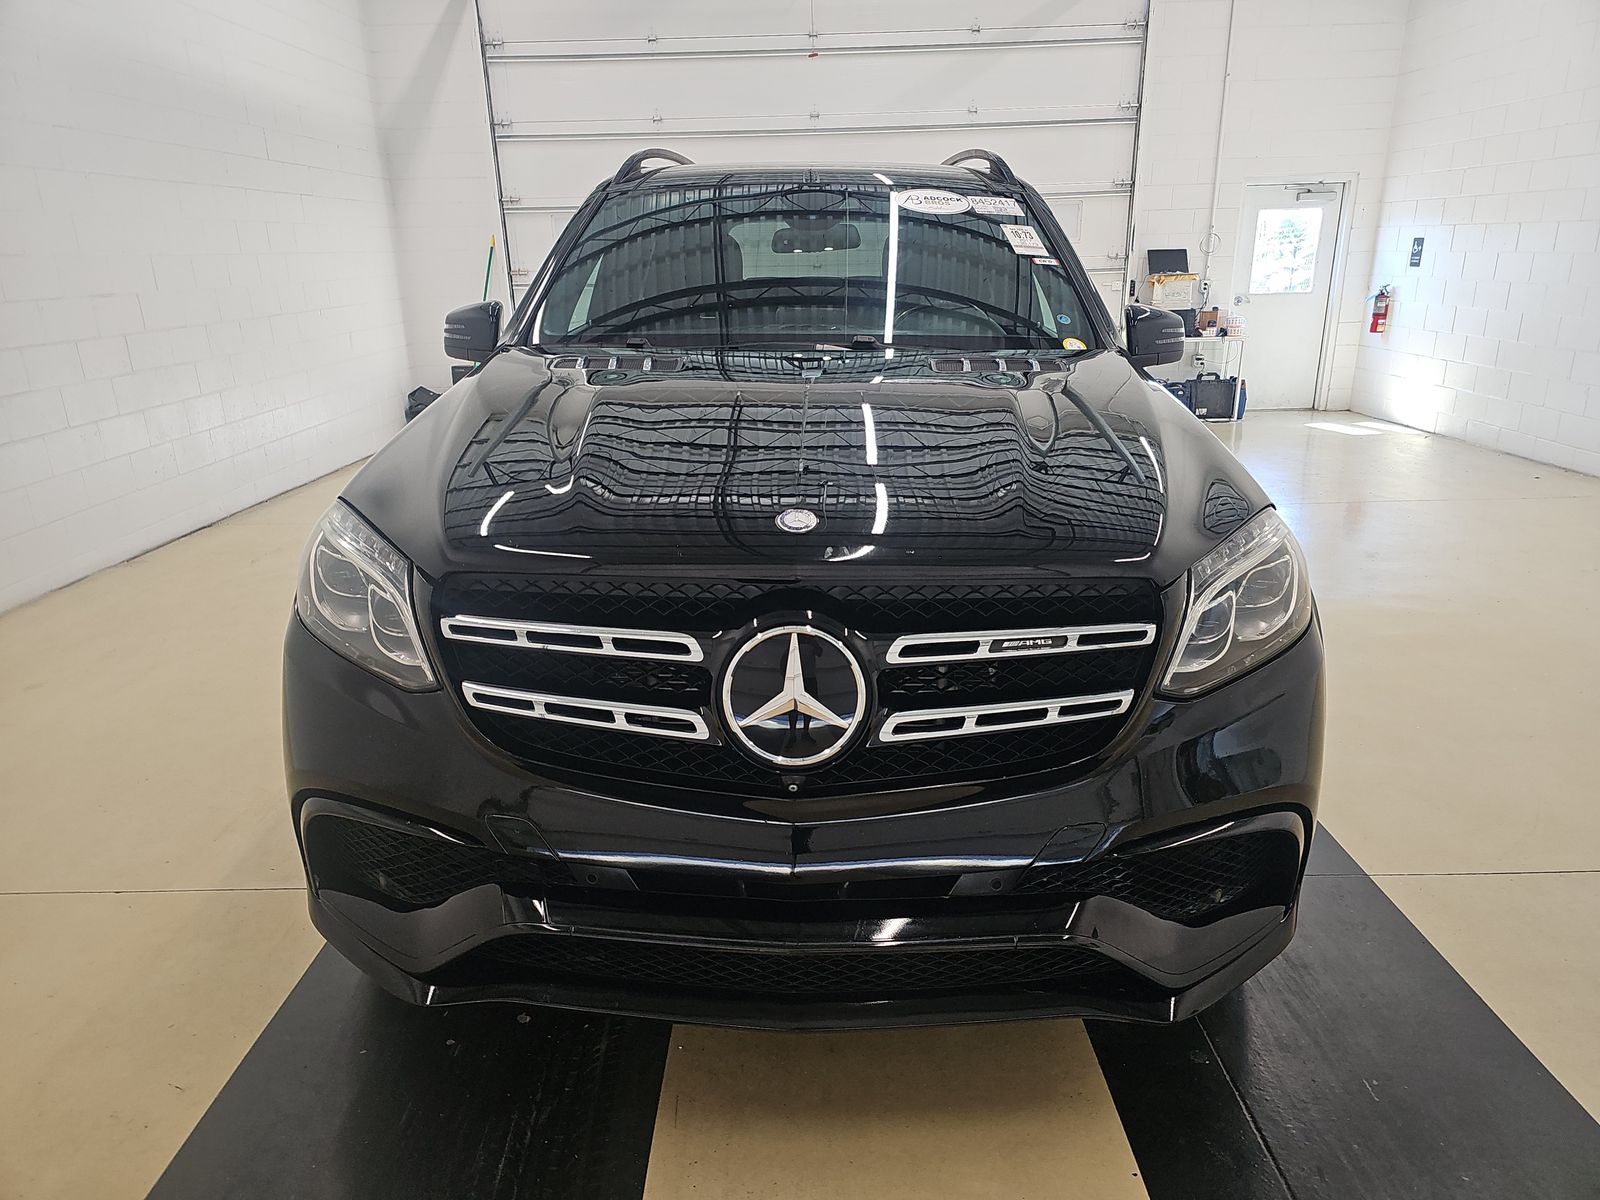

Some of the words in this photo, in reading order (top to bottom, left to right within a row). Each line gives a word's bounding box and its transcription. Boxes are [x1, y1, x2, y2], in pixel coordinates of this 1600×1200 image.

[923, 195, 963, 203] ADCOCK
[970, 197, 1016, 207] 8452417
[1018, 638, 1052, 647] AMG
